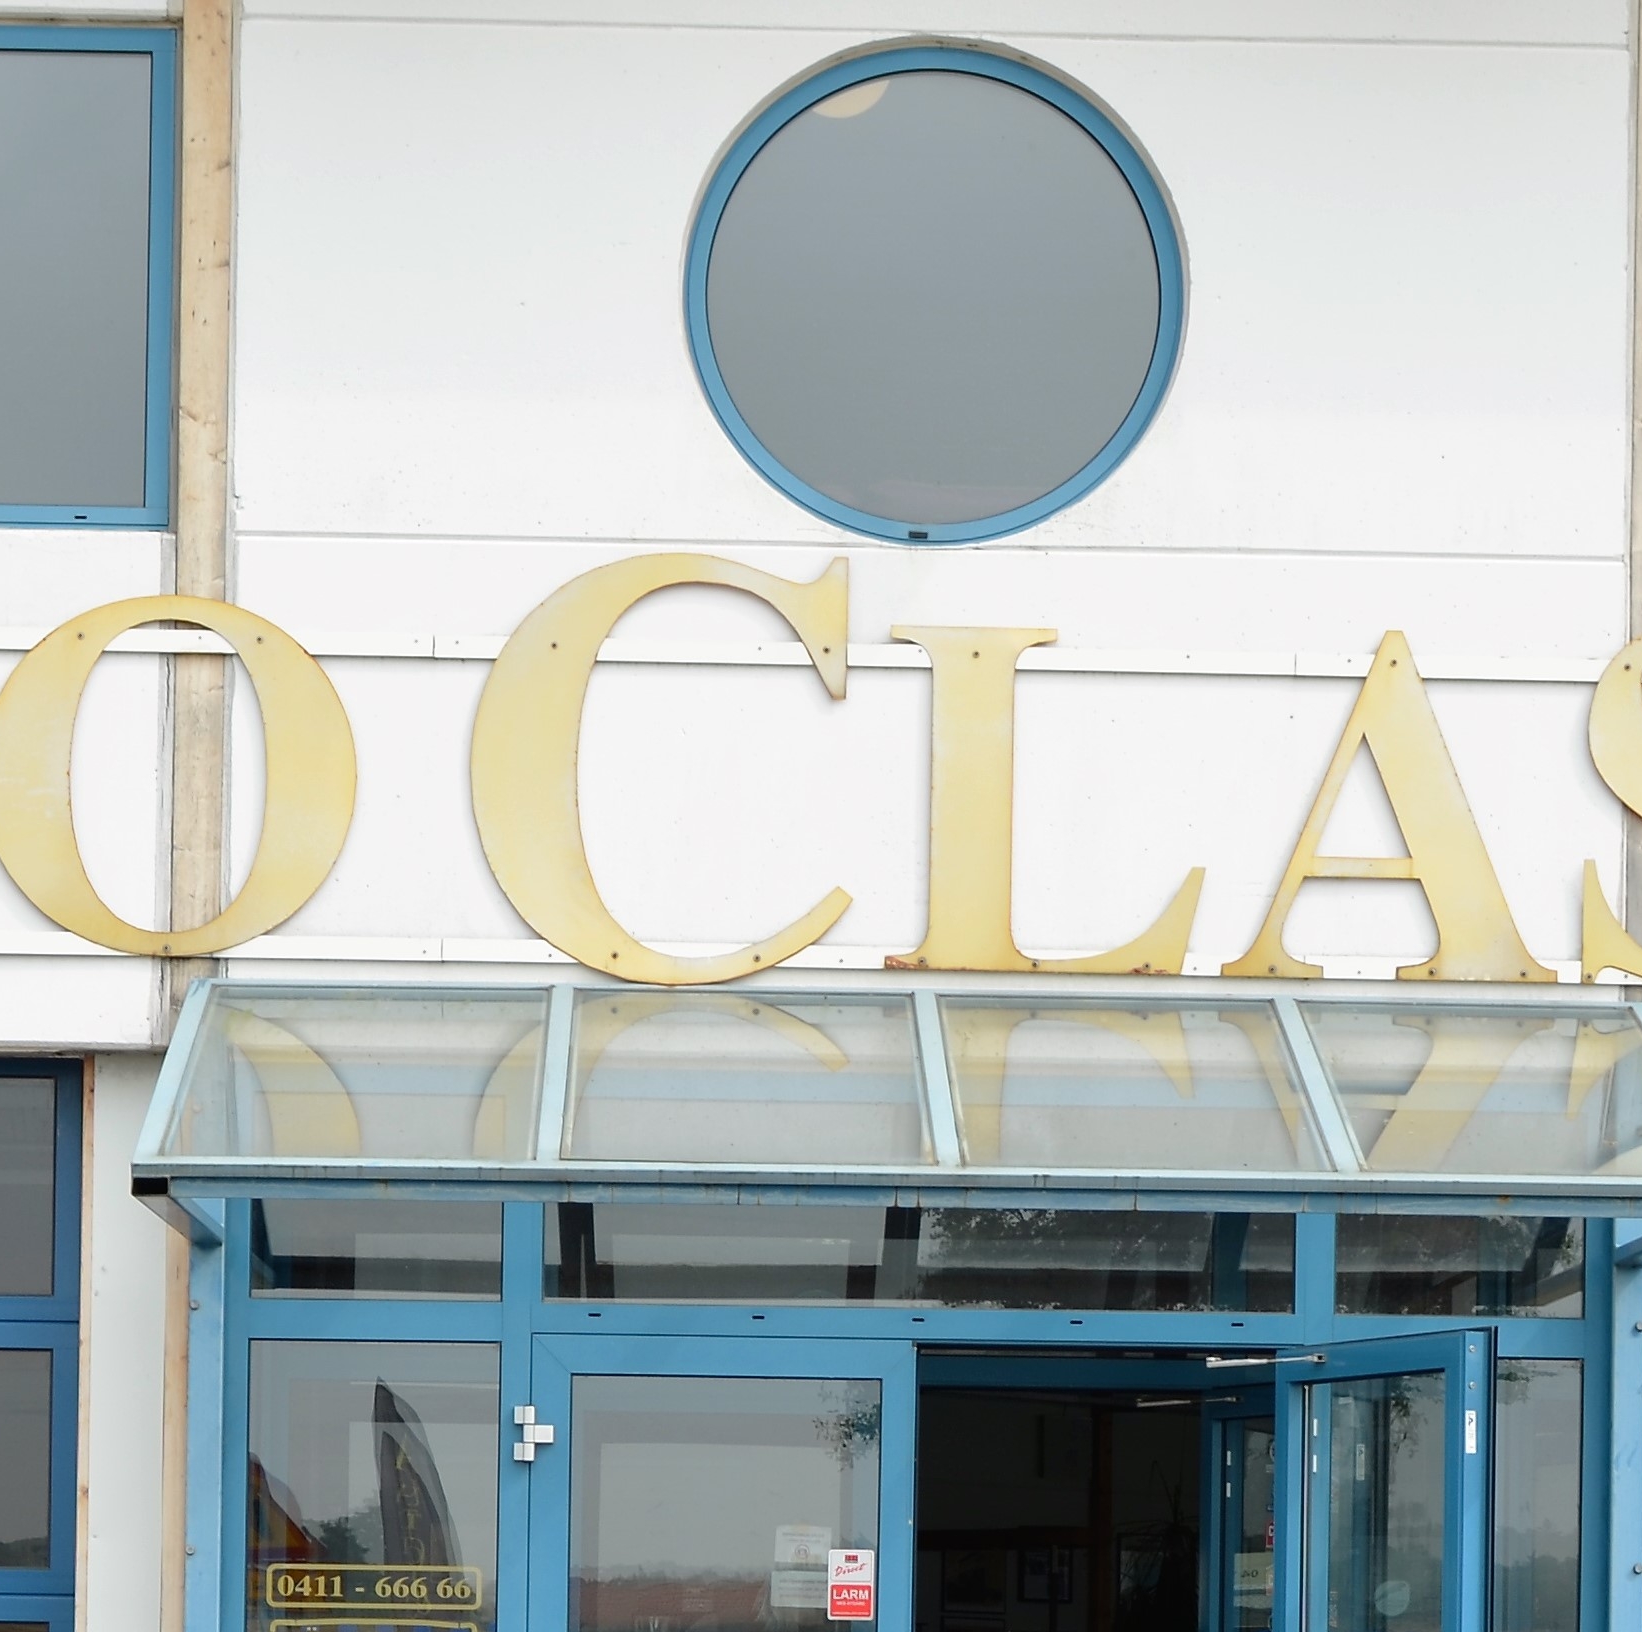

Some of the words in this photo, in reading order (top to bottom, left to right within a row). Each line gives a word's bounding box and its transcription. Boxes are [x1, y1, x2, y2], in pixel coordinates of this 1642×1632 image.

[277, 1575, 344, 1598] 0411
[375, 1577, 428, 1600] 666
[436, 1577, 472, 1599] 66
[833, 1589, 869, 1600] LARM
